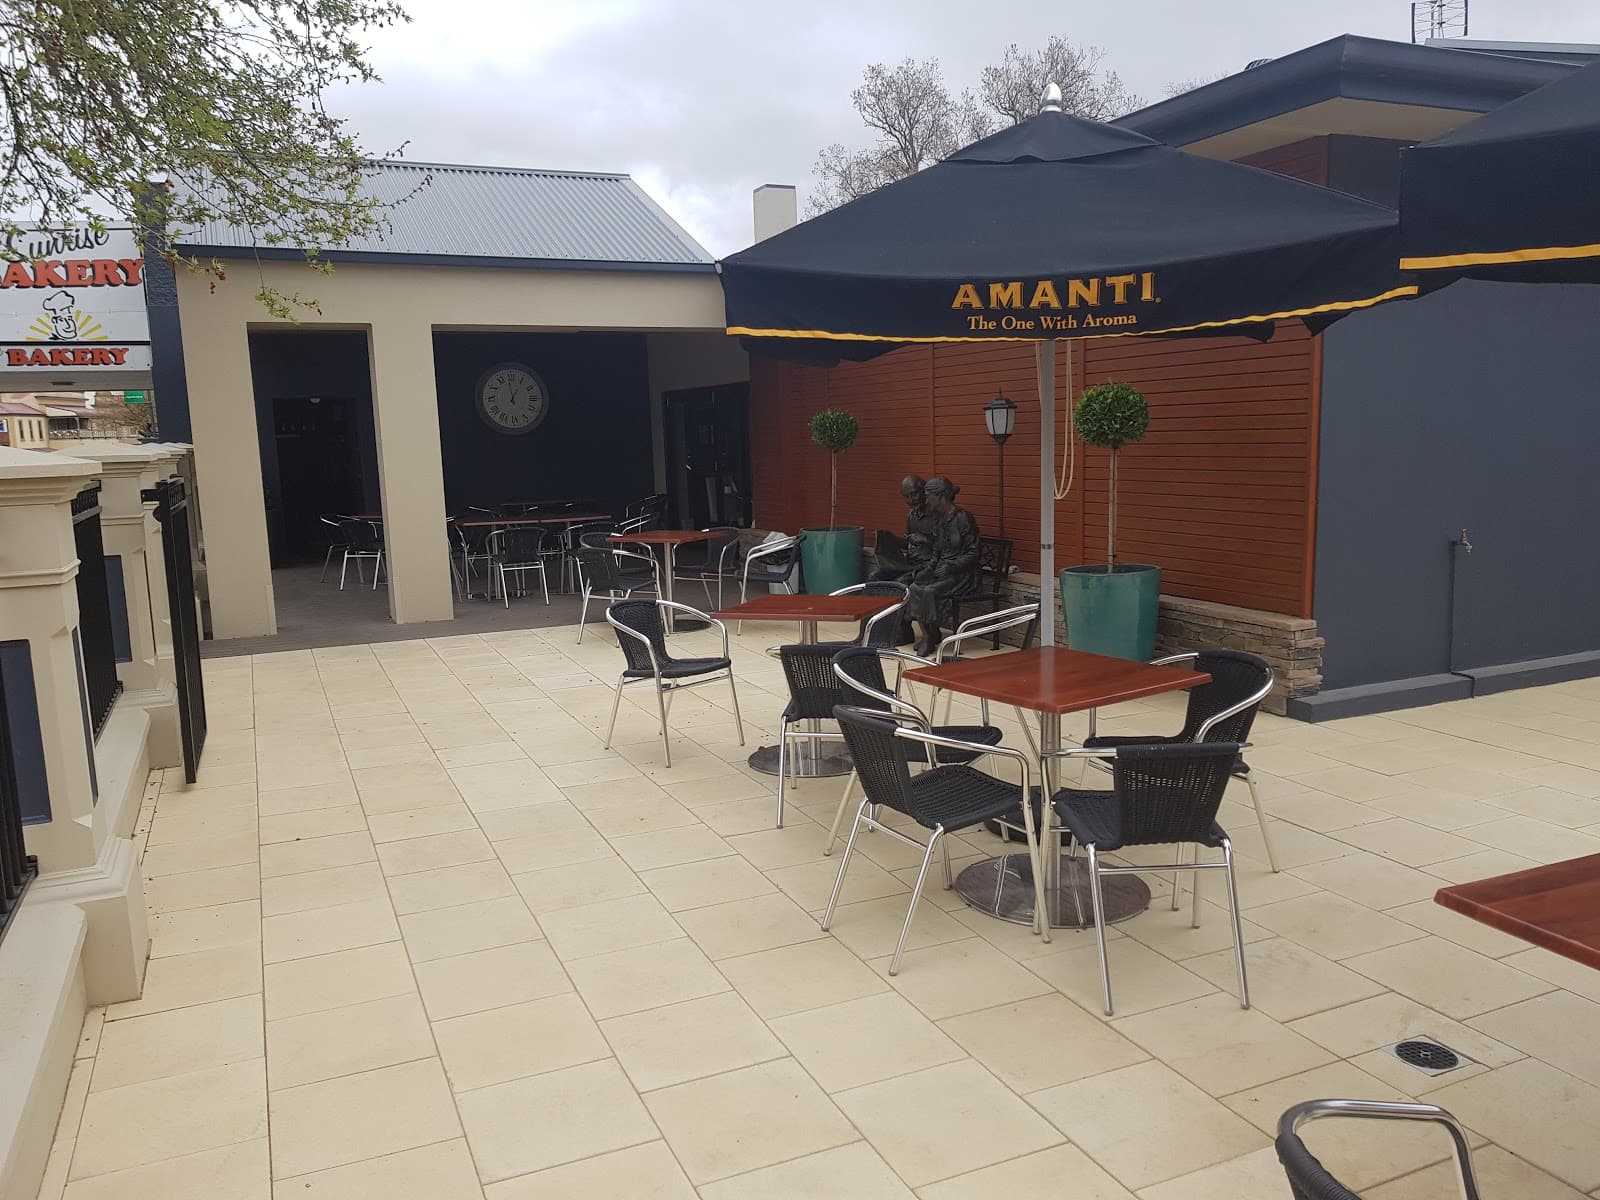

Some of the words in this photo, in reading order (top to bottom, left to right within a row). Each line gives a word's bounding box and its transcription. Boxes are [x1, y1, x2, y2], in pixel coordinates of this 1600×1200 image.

[0, 259, 144, 288] AKERY
[951, 272, 1156, 309] AMANTI
[967, 315, 997, 330] The
[1001, 315, 1035, 330] One
[1040, 315, 1077, 330] With
[1082, 313, 1137, 328] Aroma
[6, 348, 129, 366] BAKERY
